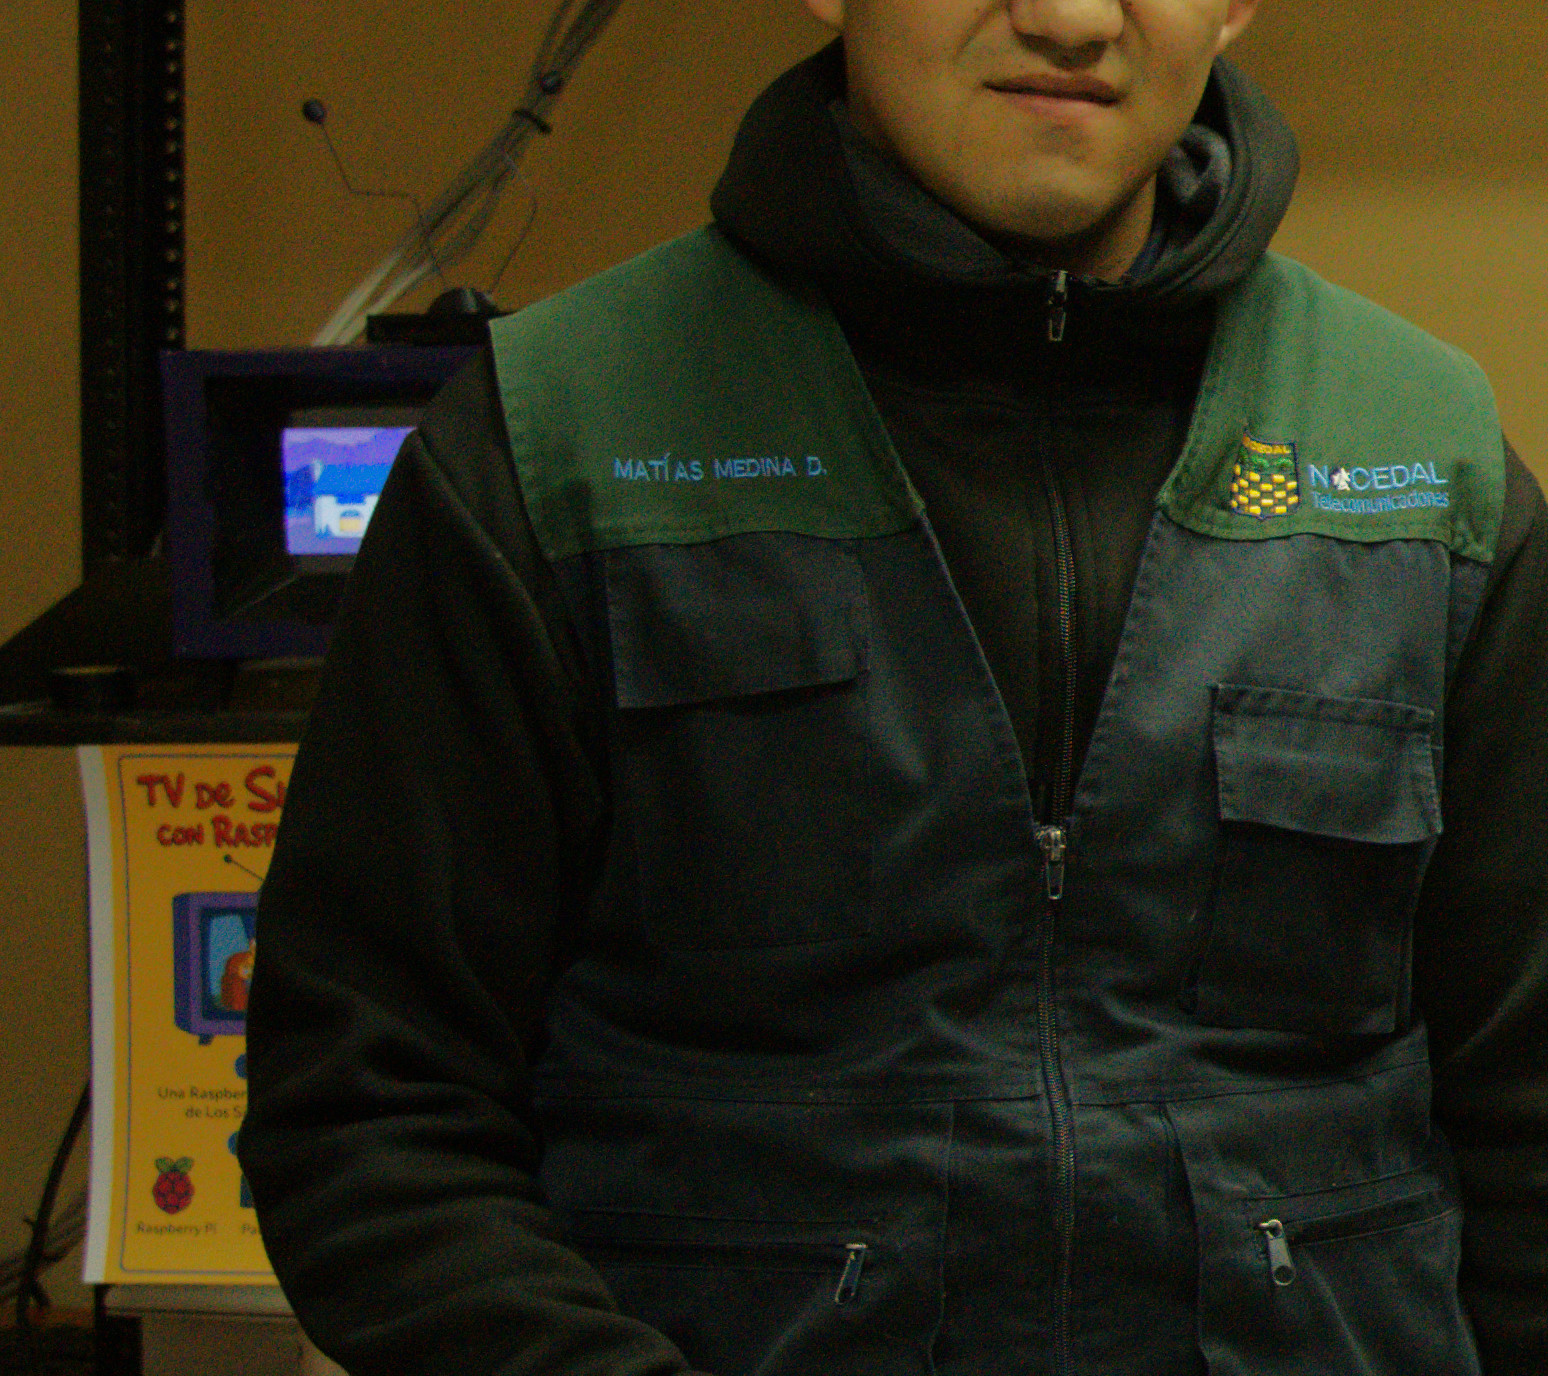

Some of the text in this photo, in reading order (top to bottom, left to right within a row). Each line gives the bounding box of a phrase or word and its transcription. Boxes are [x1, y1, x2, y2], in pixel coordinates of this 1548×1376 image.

[613, 452, 828, 482] MATÍAS MEDINA D.
[1311, 490, 1450, 515] Telecomunicaciones
[137, 772, 186, 809] TV
[211, 814, 279, 849] RASP
[190, 1085, 248, 1103] Raspber
[205, 1106, 230, 1118] Los
